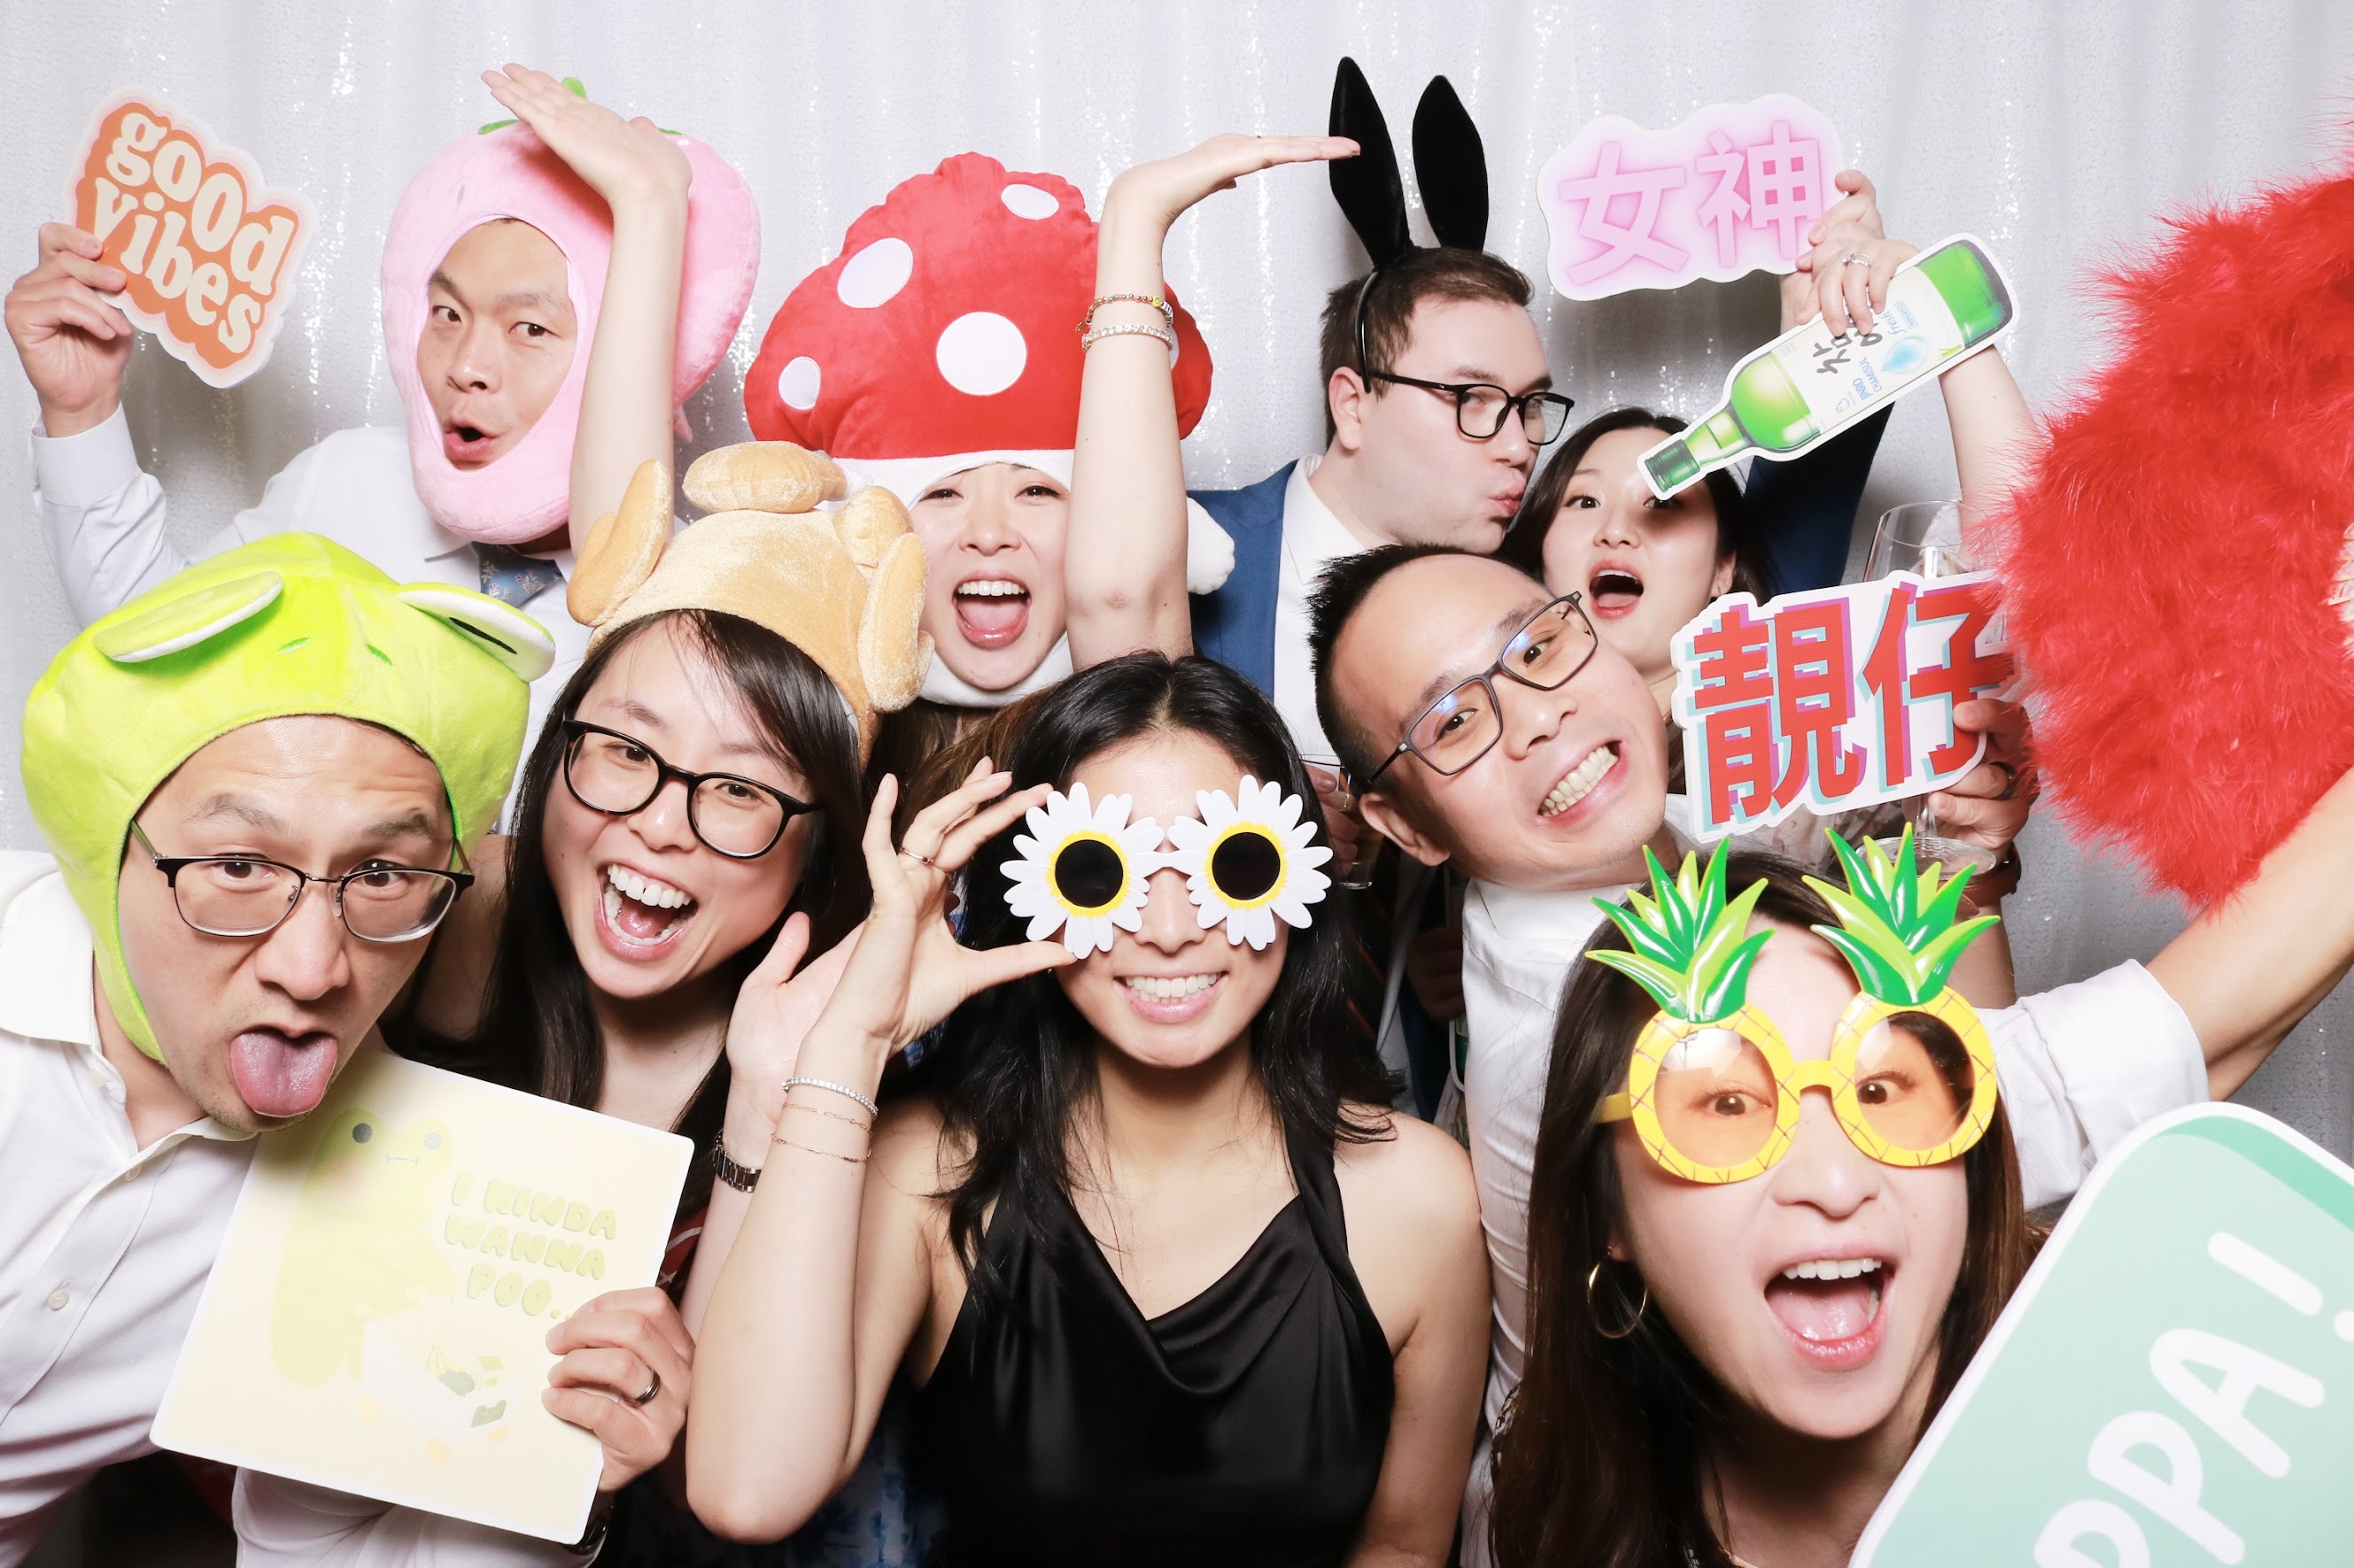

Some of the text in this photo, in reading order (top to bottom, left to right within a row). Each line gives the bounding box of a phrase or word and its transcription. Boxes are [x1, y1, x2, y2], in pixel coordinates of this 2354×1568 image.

[105, 112, 295, 296] good
[1558, 120, 1824, 286] 女神
[93, 176, 261, 353] vibes
[1878, 311, 1907, 336] fresh
[1852, 377, 1873, 401] JINRO
[1858, 356, 1883, 393] CHAMISUL
[1688, 584, 2015, 827] 靚仔
[452, 1171, 617, 1240] I KINDA
[445, 1213, 607, 1280] WANNA
